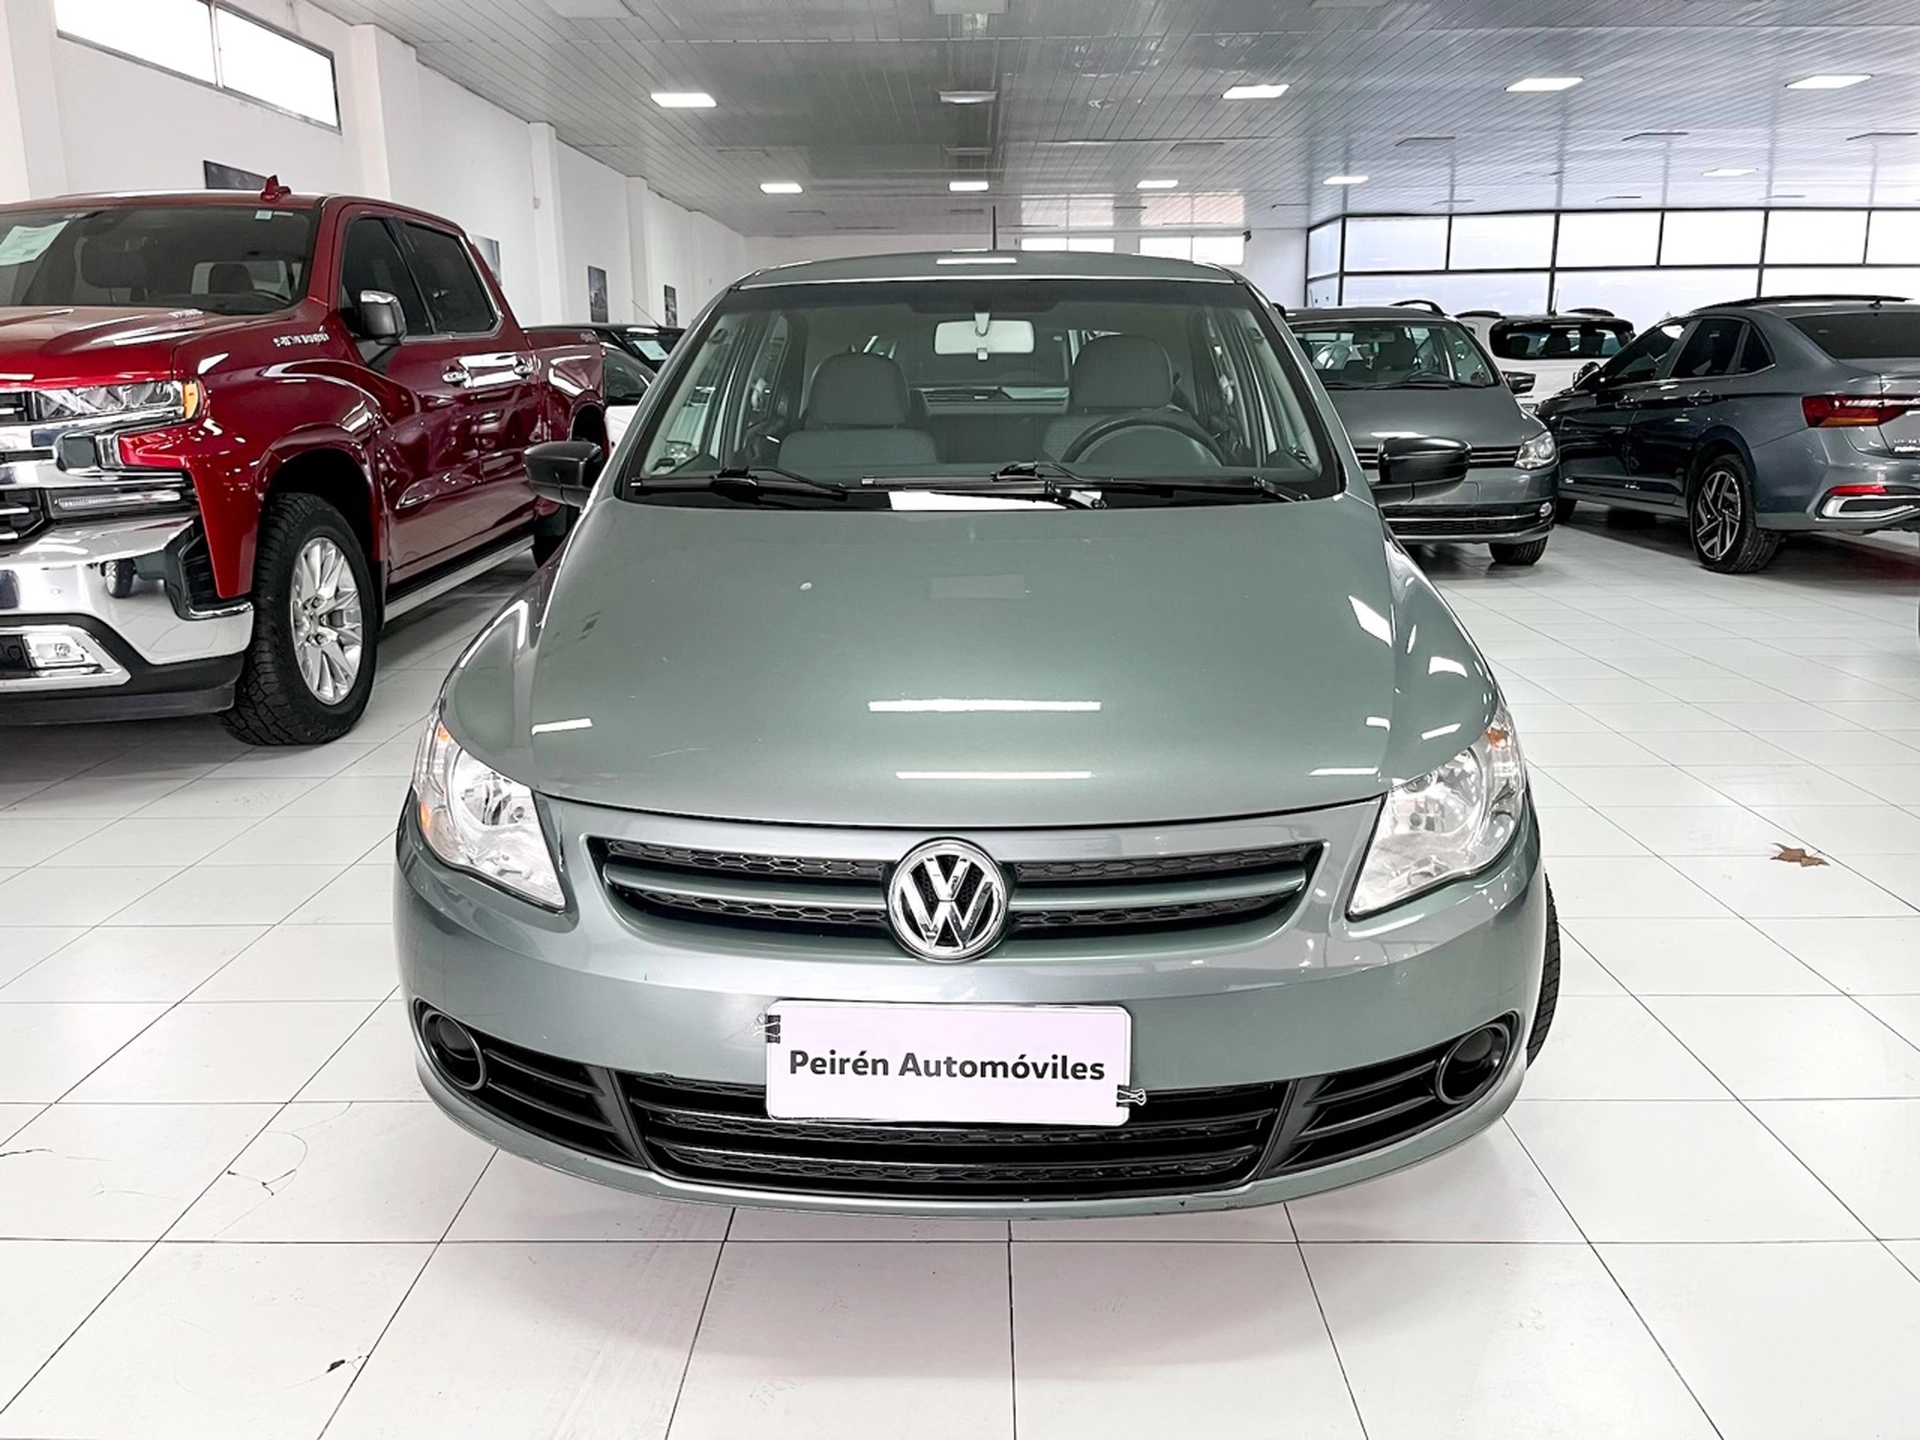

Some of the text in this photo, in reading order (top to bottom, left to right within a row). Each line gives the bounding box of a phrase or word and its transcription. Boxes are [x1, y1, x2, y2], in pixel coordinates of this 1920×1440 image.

[893, 844, 1000, 956] VW
[789, 1049, 1105, 1080] Peirén Automóviles
